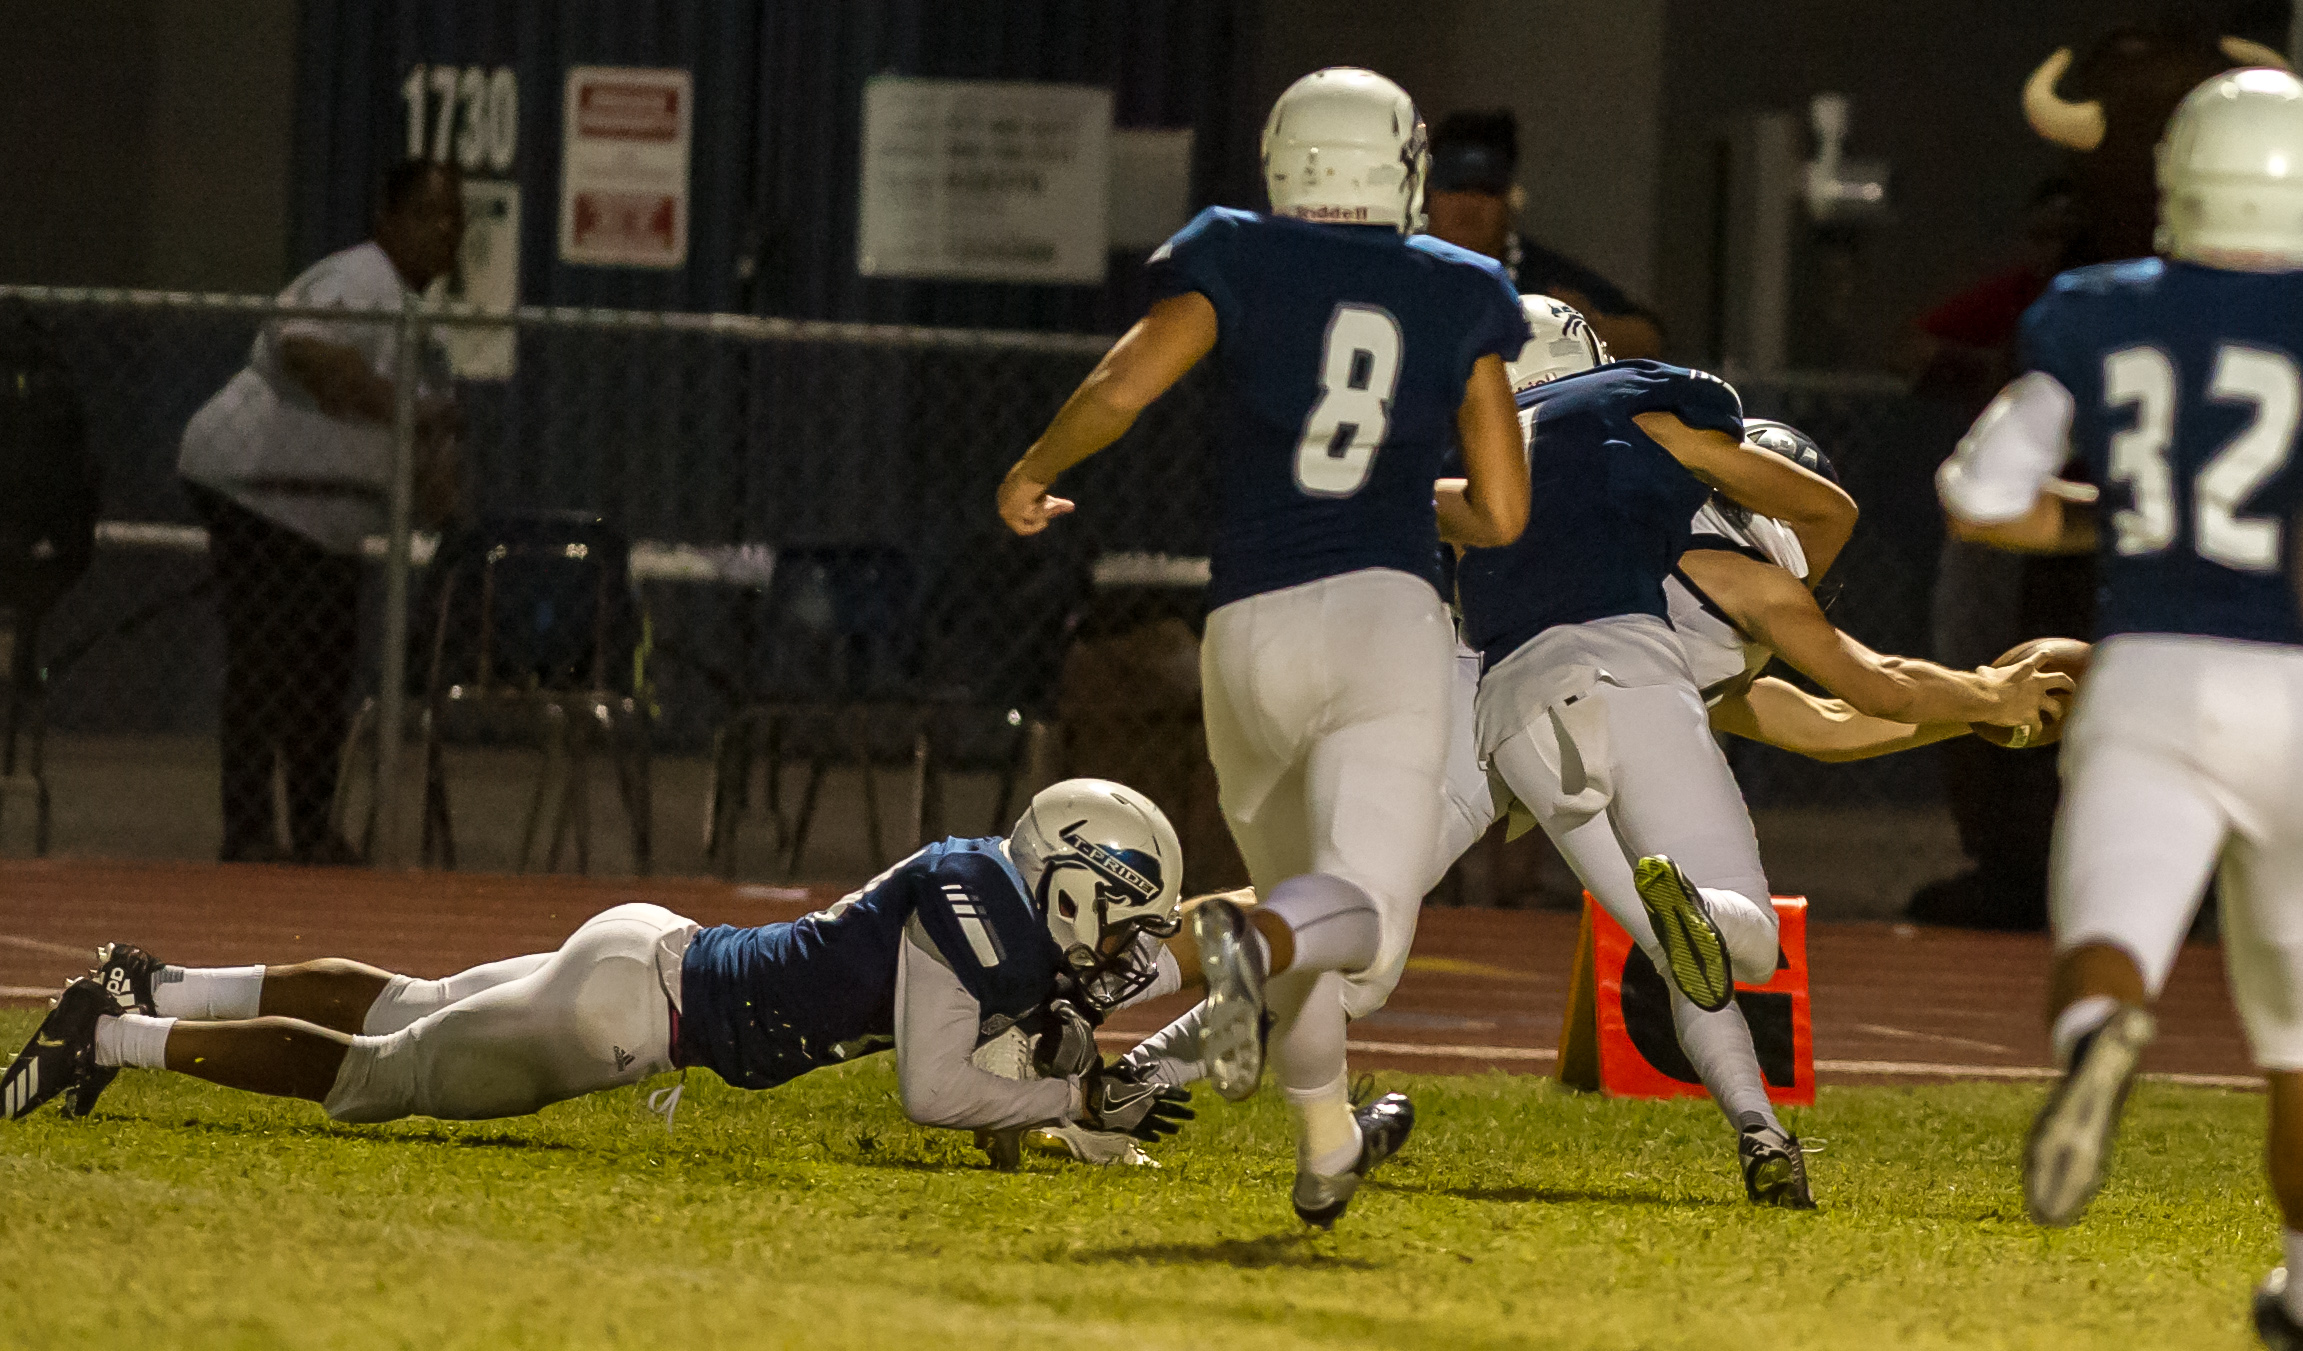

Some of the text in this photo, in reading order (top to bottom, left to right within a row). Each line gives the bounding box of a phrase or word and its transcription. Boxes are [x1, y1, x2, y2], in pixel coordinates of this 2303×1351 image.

[403, 64, 518, 170] 1730
[1295, 303, 1403, 496] 8
[2103, 344, 2301, 571] 32
[1073, 835, 1155, 893] T-PRIDE
